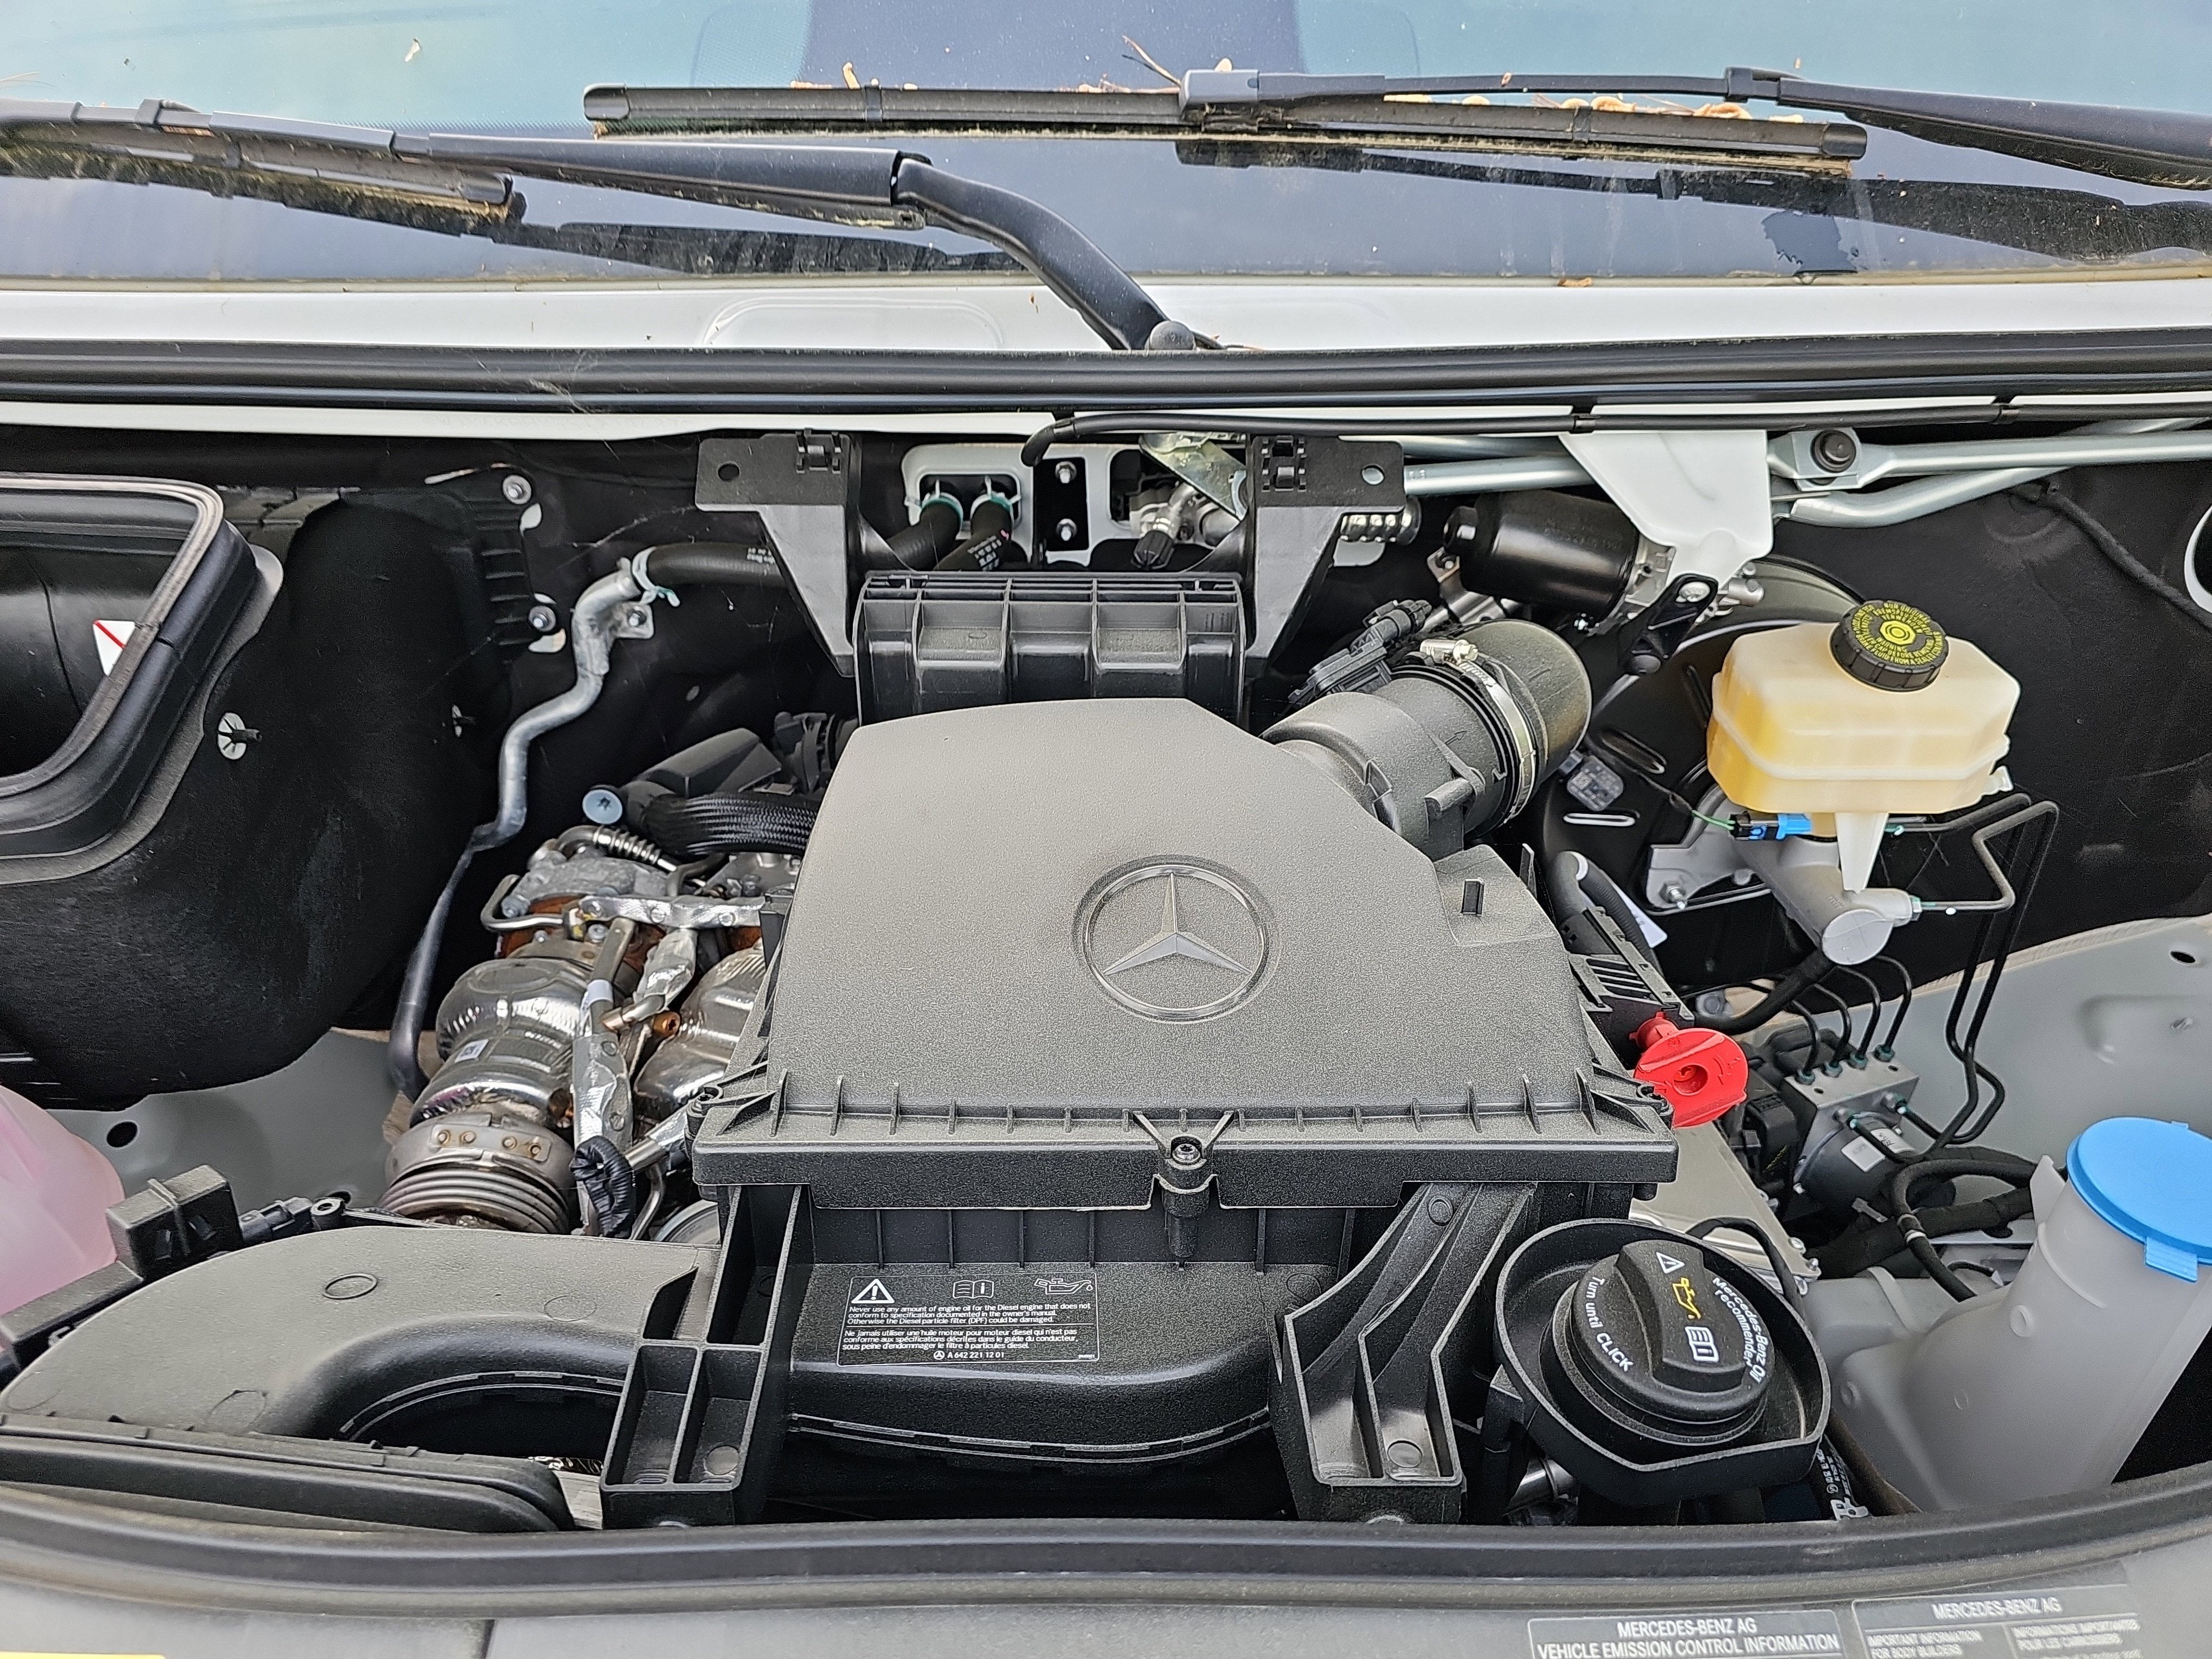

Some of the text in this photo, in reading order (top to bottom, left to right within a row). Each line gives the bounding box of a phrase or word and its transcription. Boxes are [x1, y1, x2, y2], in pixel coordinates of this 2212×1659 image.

[1586, 1277, 1634, 1372] Turn until CLICK
[1712, 1277, 1769, 1384] Mercedes-Benz Oil
[1931, 1597, 2063, 1619] MERCEDES-BENZ AG
[1617, 1617, 1758, 1638] MERCEDES-BENZ AG
[1537, 1633, 1841, 1659] VEHICLE EMISSION CONTROL INFORMATION
